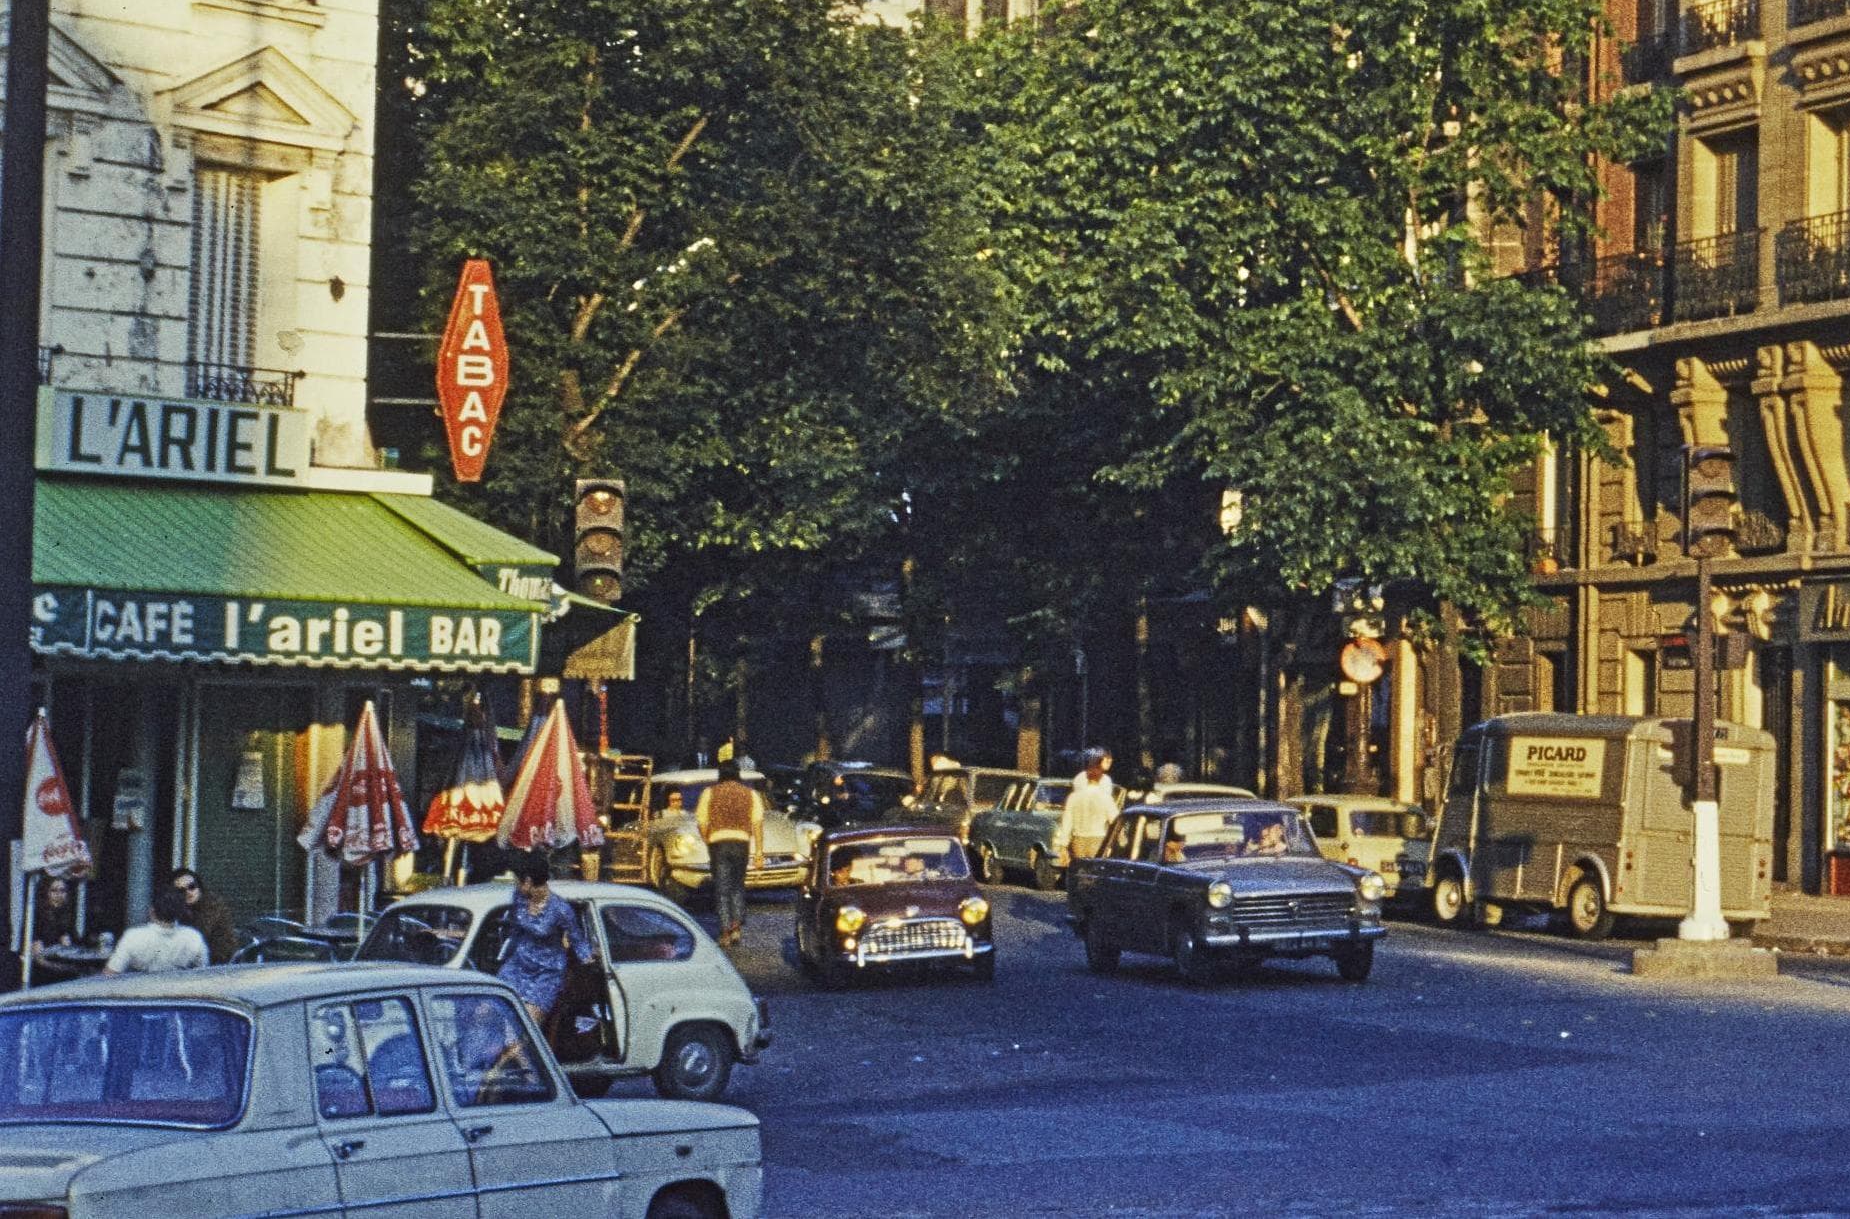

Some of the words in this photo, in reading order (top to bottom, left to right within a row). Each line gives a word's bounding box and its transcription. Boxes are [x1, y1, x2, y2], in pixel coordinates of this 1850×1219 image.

[457, 284, 494, 457] TABAC
[69, 395, 296, 478] L'ARIEL
[225, 601, 403, 656] l'ariel
[430, 615, 501, 655] BAR
[1527, 745, 1587, 762] PICARD
